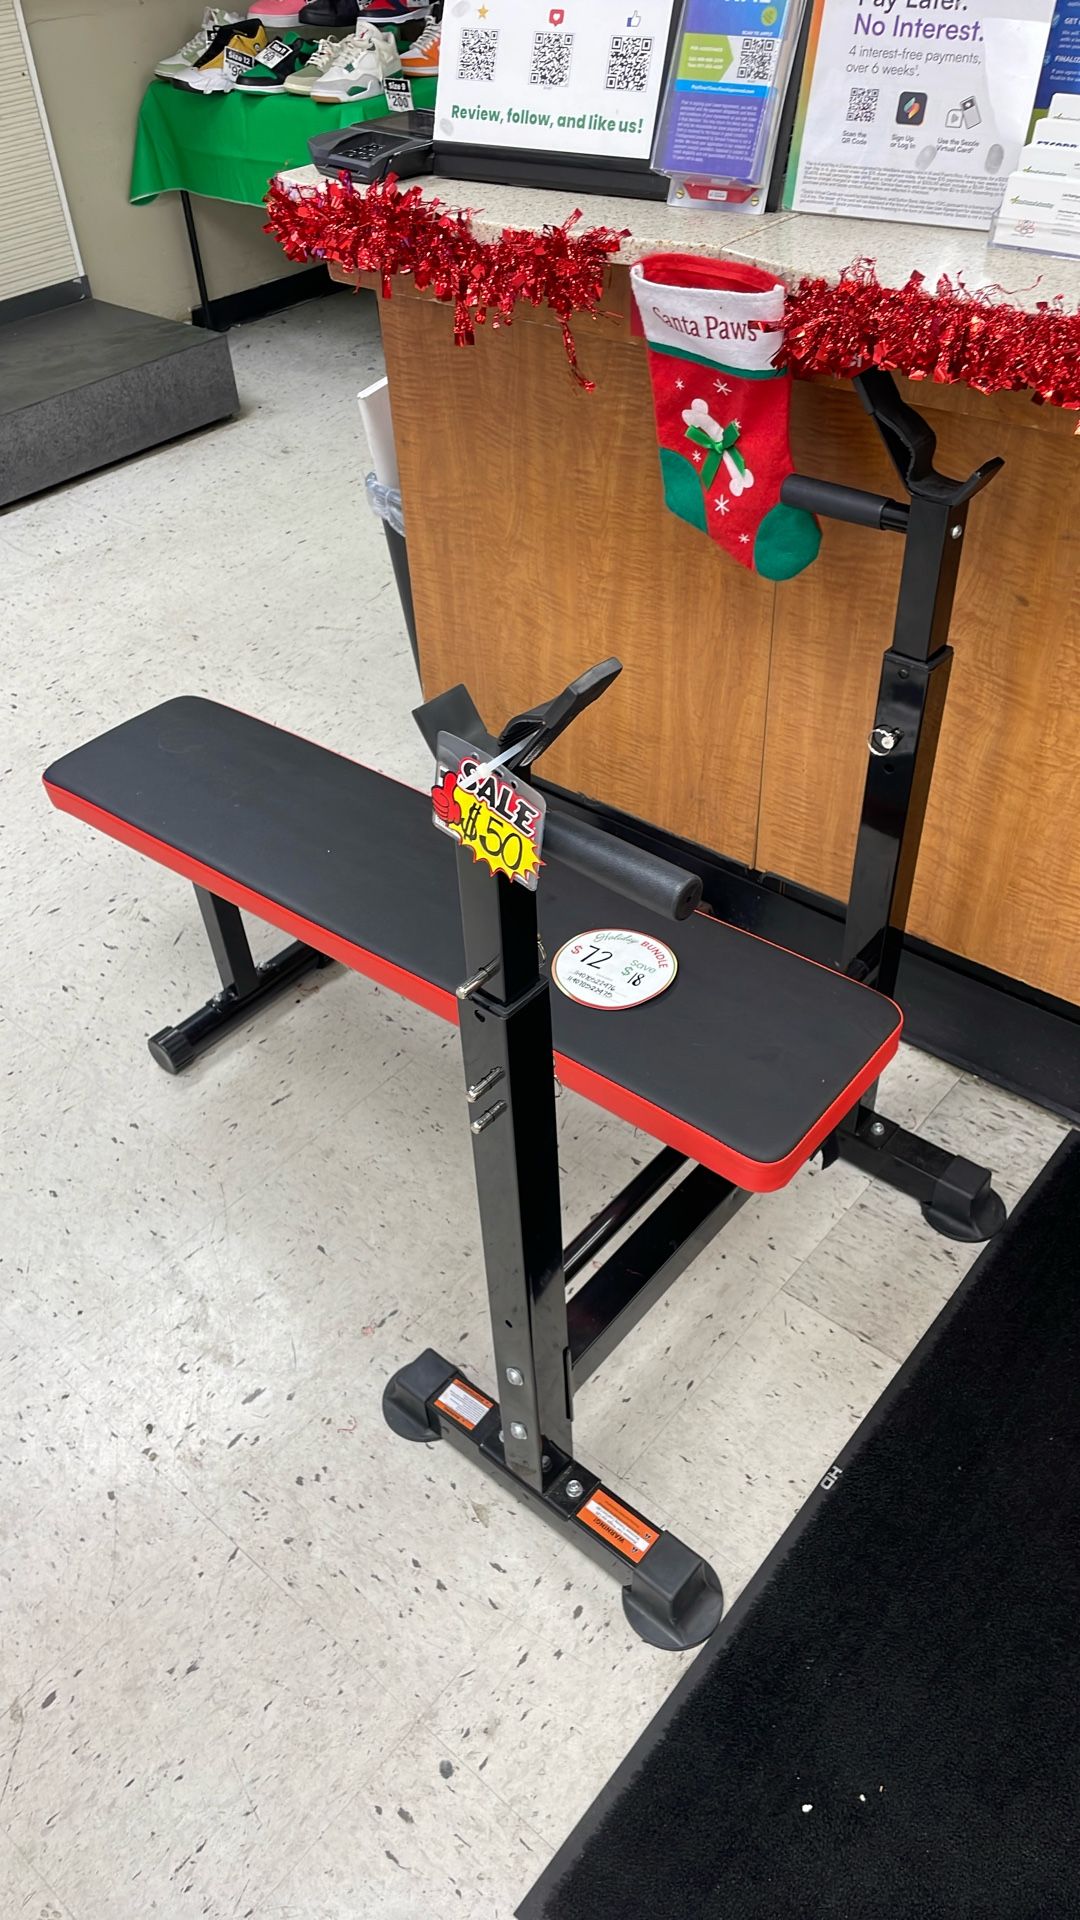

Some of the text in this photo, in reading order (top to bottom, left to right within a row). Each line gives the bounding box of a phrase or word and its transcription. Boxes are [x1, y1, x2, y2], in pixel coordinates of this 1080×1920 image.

[854, 13, 984, 42] No Interest.
[228, 51, 251, 65] Size 12
[849, 45, 982, 65] 4 interest-free payments,
[846, 63, 869, 73] over
[871, 62, 879, 74] 6
[388, 81, 401, 90] Size
[451, 105, 644, 134] Review, follow, and like us!
[843, 130, 856, 138] Scan
[891, 134, 903, 142] Sign
[898, 142, 908, 150] Log
[652, 306, 757, 341] Santa Paws
[458, 760, 538, 836] SALE
[593, 932, 668, 969] Holiday BUNDLE
[593, 1517, 625, 1544] WARNING!
